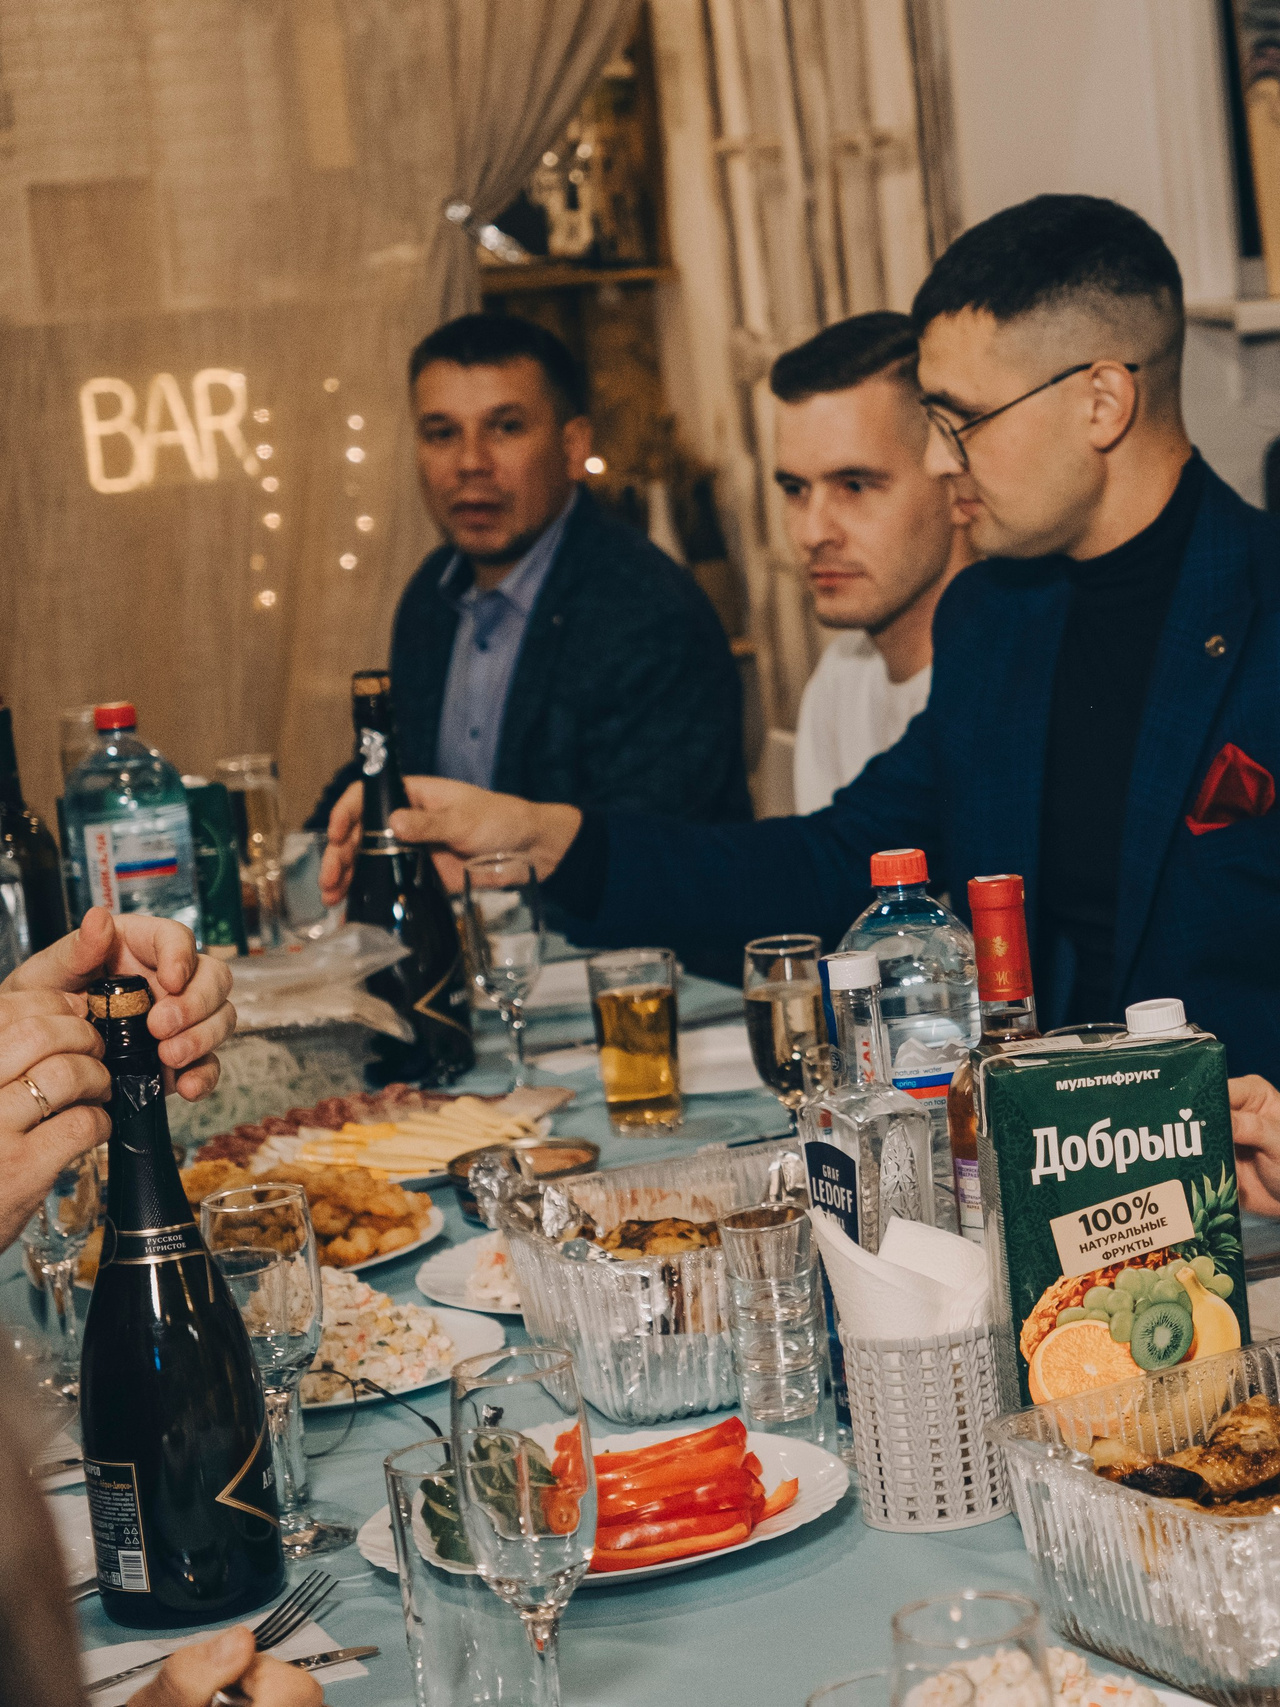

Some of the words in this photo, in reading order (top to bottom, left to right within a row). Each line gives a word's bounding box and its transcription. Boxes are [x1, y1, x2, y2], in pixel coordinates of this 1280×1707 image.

[79, 367, 260, 494] BAR
[894, 1069, 920, 1077] natural
[923, 1066, 943, 1074] water
[1056, 1068, 1161, 1092] мультифрукт
[896, 1080, 917, 1088] spring
[934, 1098, 947, 1107] top
[1031, 1108, 1203, 1185] Добрый
[822, 1164, 840, 1182] GRAF
[811, 1176, 853, 1214] LEDOFF
[1078, 1191, 1159, 1237] 100%
[1079, 1217, 1168, 1254] НАТУРАЛЬНЫЕ
[1102, 1237, 1154, 1260] ФРУКТЫ
